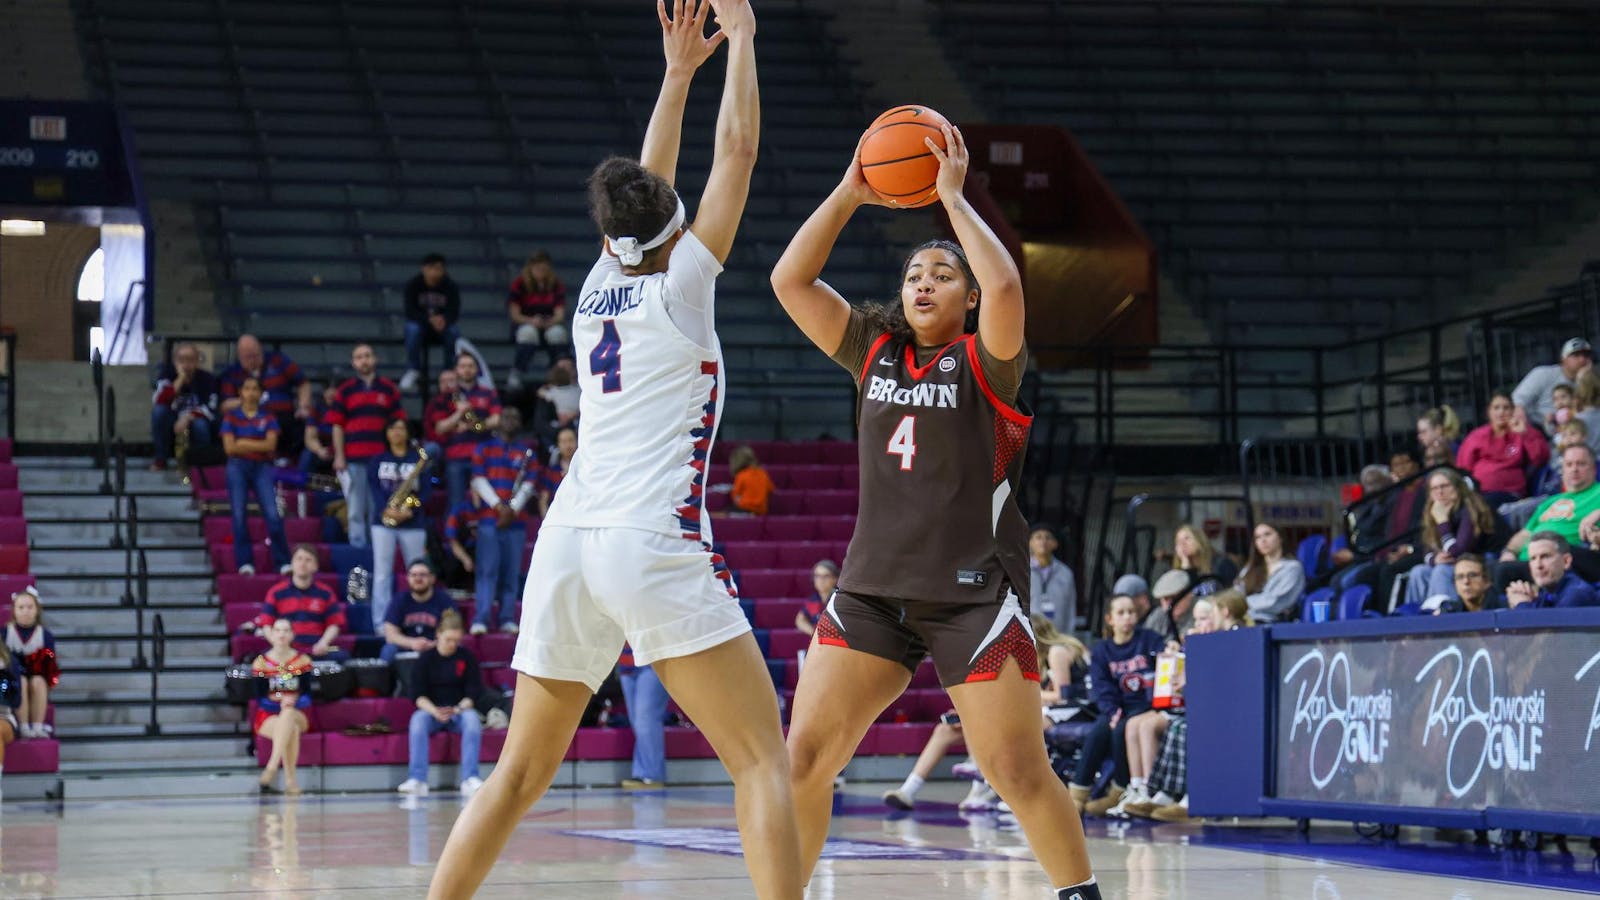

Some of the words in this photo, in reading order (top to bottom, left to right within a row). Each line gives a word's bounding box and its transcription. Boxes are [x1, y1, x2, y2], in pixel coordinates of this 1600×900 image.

[0, 148, 34, 166] 209
[66, 149, 98, 168] 210
[589, 319, 622, 394] 4
[867, 375, 958, 408] BROWN
[886, 414, 917, 471] 4
[1415, 645, 1466, 747] Ron
[1344, 720, 1390, 763] GOLF
[1487, 723, 1543, 771] GOLF
